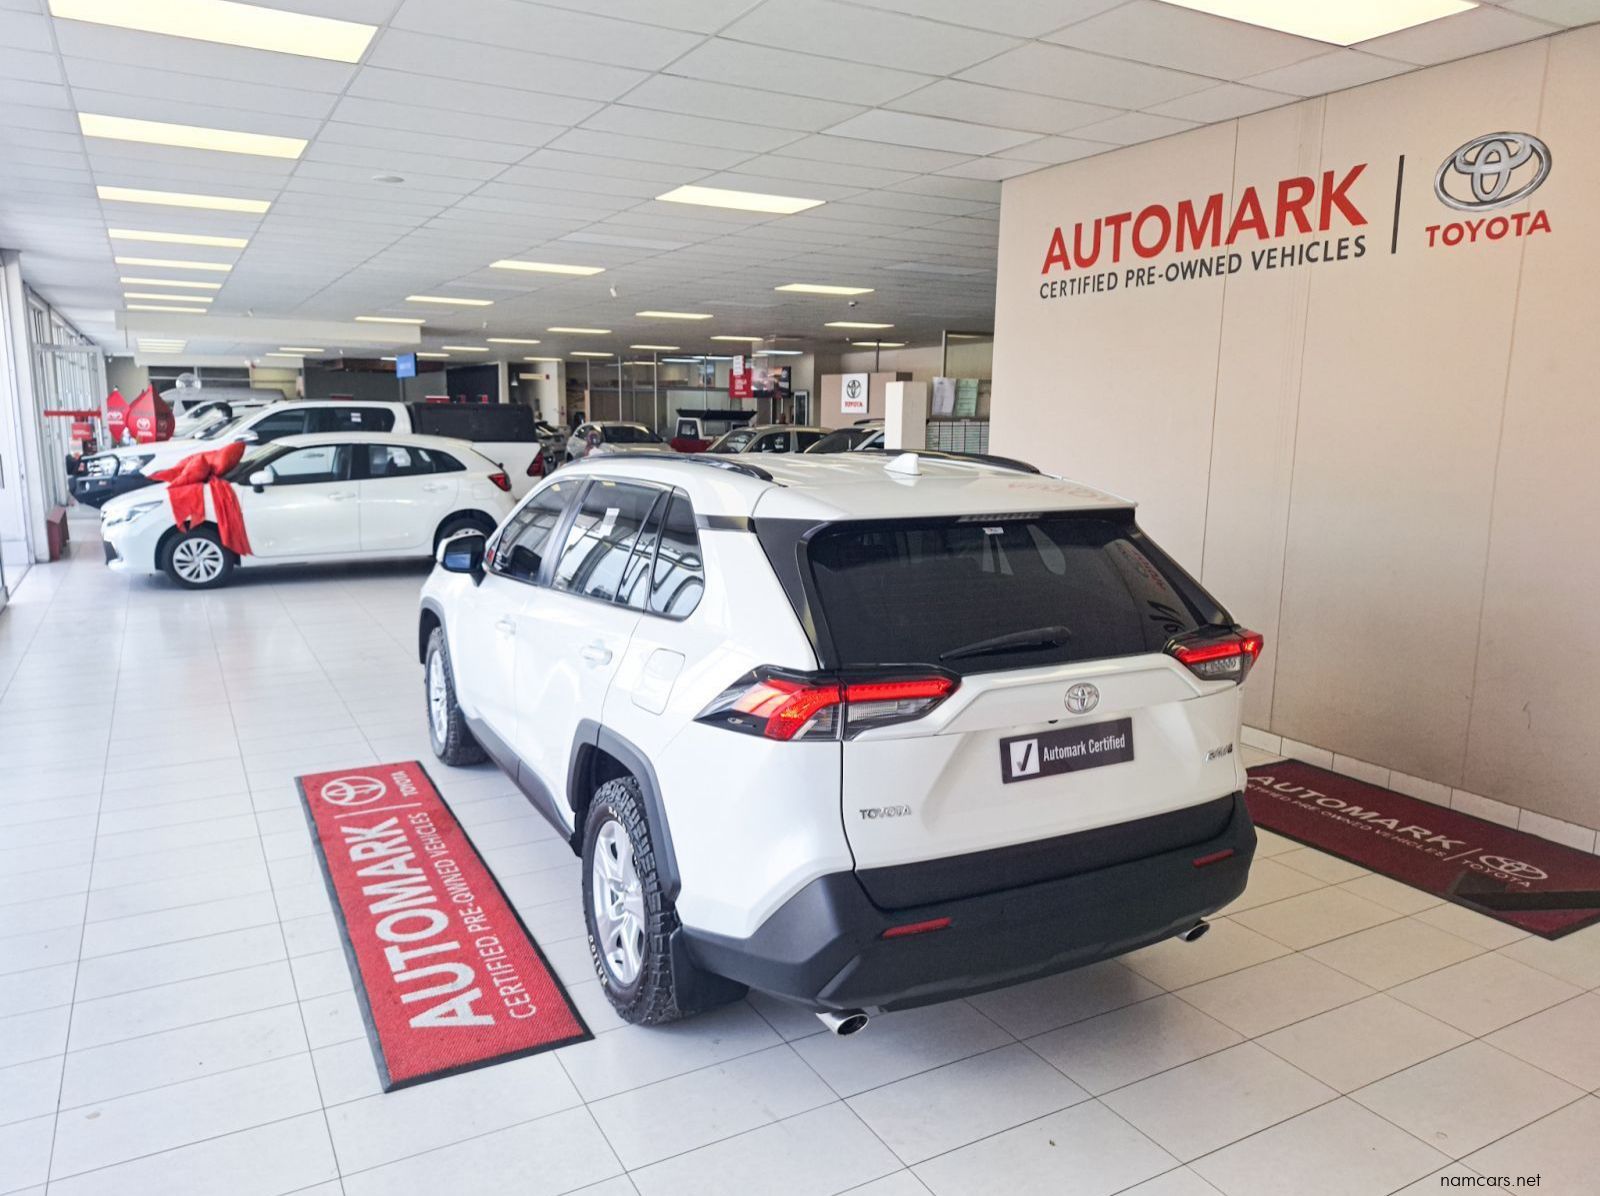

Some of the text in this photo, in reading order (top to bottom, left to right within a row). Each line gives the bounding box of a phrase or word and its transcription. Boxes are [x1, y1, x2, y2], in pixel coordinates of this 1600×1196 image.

[1041, 163, 1369, 275] AUTOMARK
[1425, 209, 1552, 248] TOYOTA
[1039, 234, 1367, 299] CERTIFIED PRE-OWNED VEHICLES
[1043, 733, 1126, 762] Automark Certified
[391, 770, 418, 797] TOYOTA
[859, 804, 912, 820] TOYOTA
[1248, 775, 1466, 849] AUTOMARK
[1375, 828, 1447, 857] VEHICLES
[1461, 858, 1531, 889] TOYOTA
[340, 816, 496, 1028] AUTOMARK
[408, 812, 538, 1020] CERTIFIED PRE-OWNED VEHICLES
